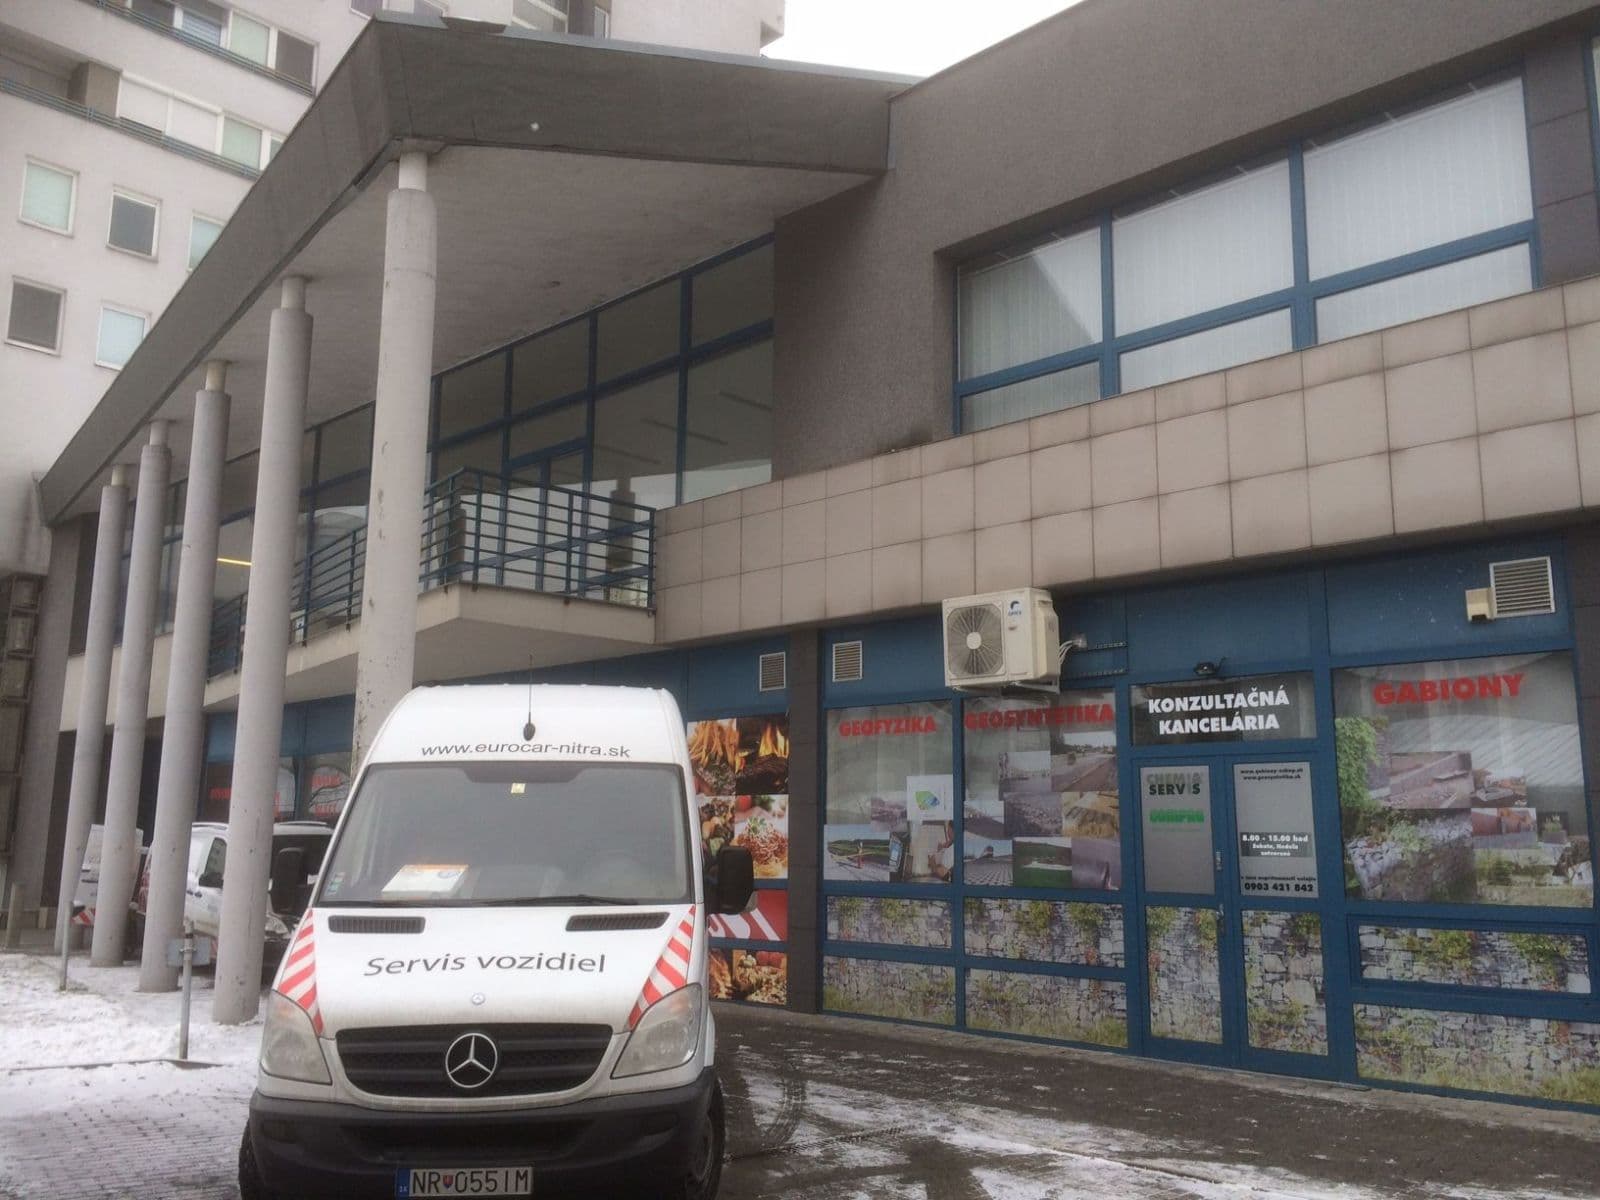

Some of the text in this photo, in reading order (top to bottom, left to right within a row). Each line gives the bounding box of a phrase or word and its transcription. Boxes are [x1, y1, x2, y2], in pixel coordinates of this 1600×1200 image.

[1148, 685, 1290, 714] KONZULTAČNÁ
[1373, 672, 1525, 706] GABIONY
[839, 715, 938, 738] GEOFYZIKA
[964, 703, 1115, 731] GEOSYNTETIKA
[1159, 711, 1280, 736] KANCELÁRIA
[421, 742, 631, 759] www.eurocar-nitra.sk
[1149, 783, 1201, 796] SERVIS
[1244, 882, 1270, 892] 0903
[1272, 882, 1291, 892] 421
[364, 952, 606, 977] Servis vozidiel
[412, 1170, 441, 1194] NR
